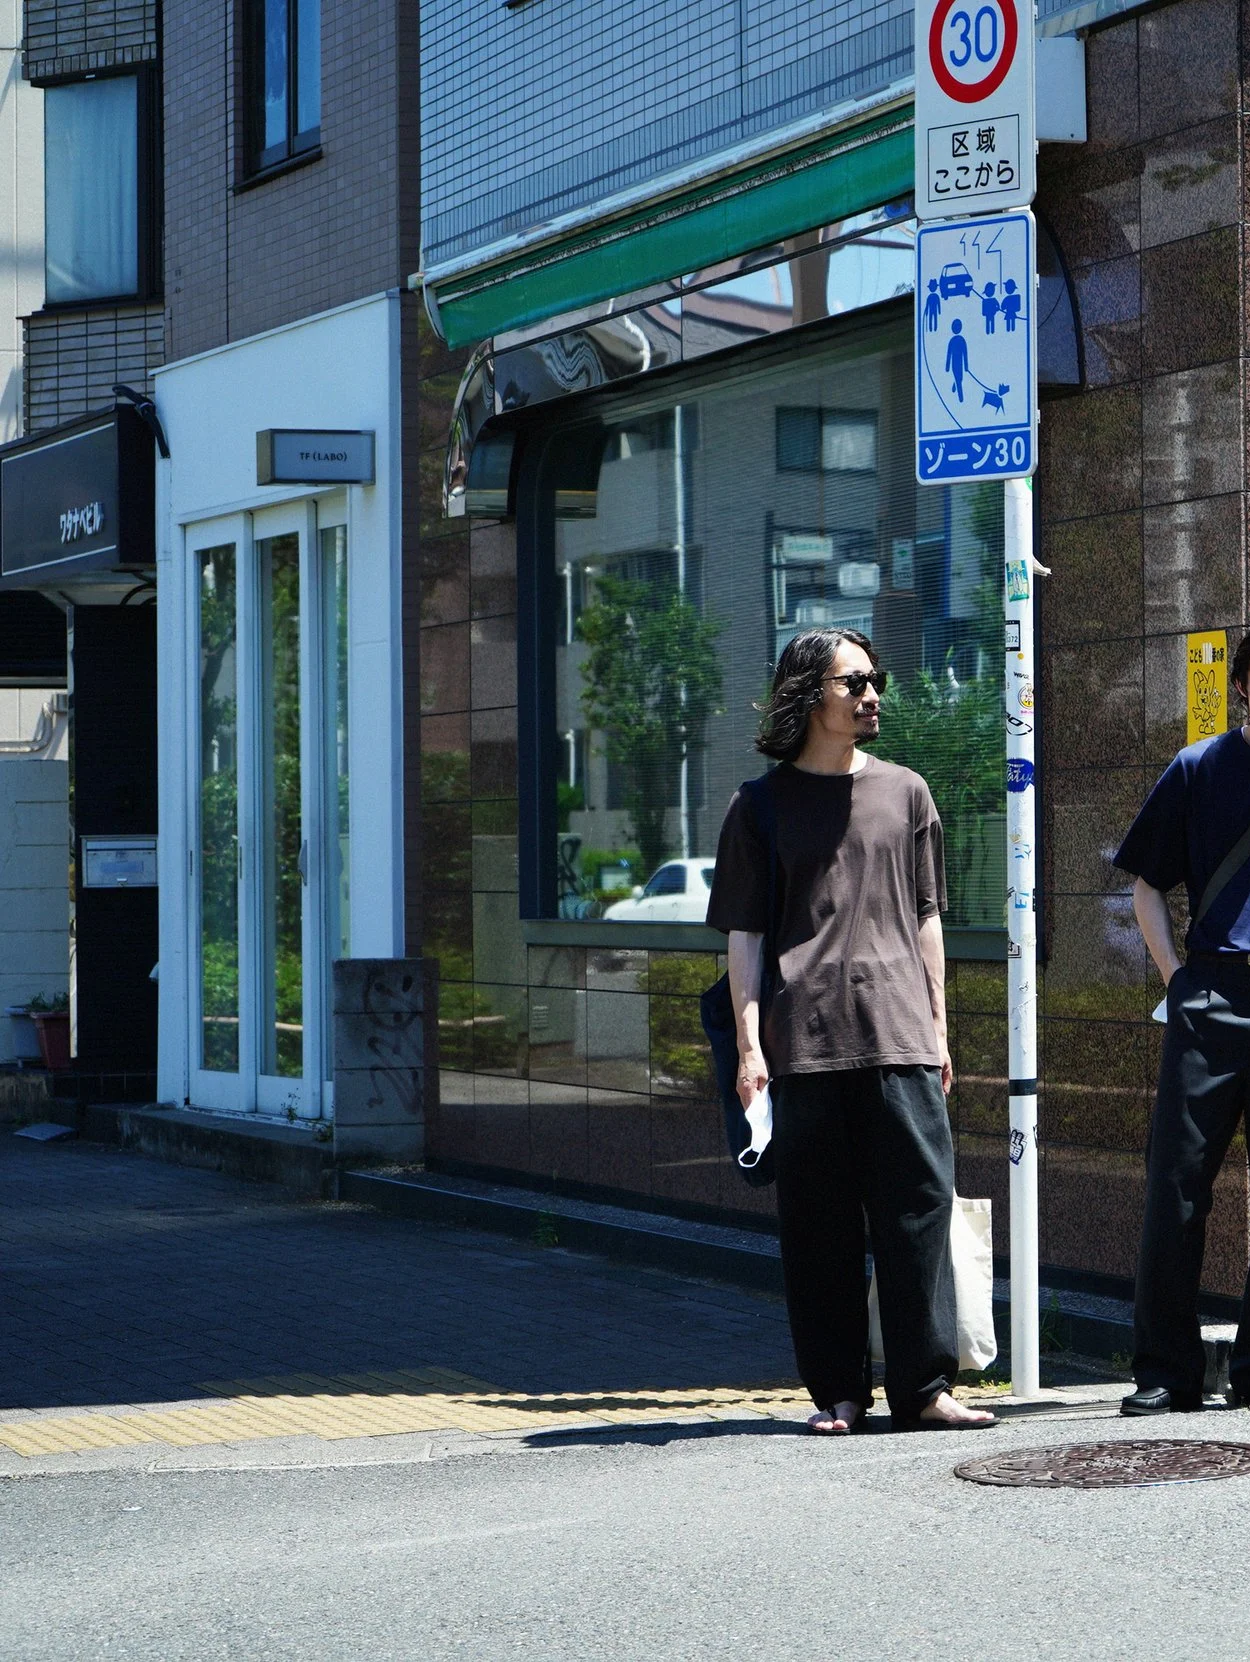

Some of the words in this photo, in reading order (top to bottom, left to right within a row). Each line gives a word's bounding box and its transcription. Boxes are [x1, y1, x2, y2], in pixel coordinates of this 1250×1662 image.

[949, 5, 998, 68] 30
[951, 126, 996, 158] 区域
[934, 159, 1015, 194] ここから
[299, 452, 311, 461] TF
[313, 451, 348, 462] (LABO)
[925, 435, 1026, 473] ゾーン30
[59, 501, 101, 544] ワタナベビル
